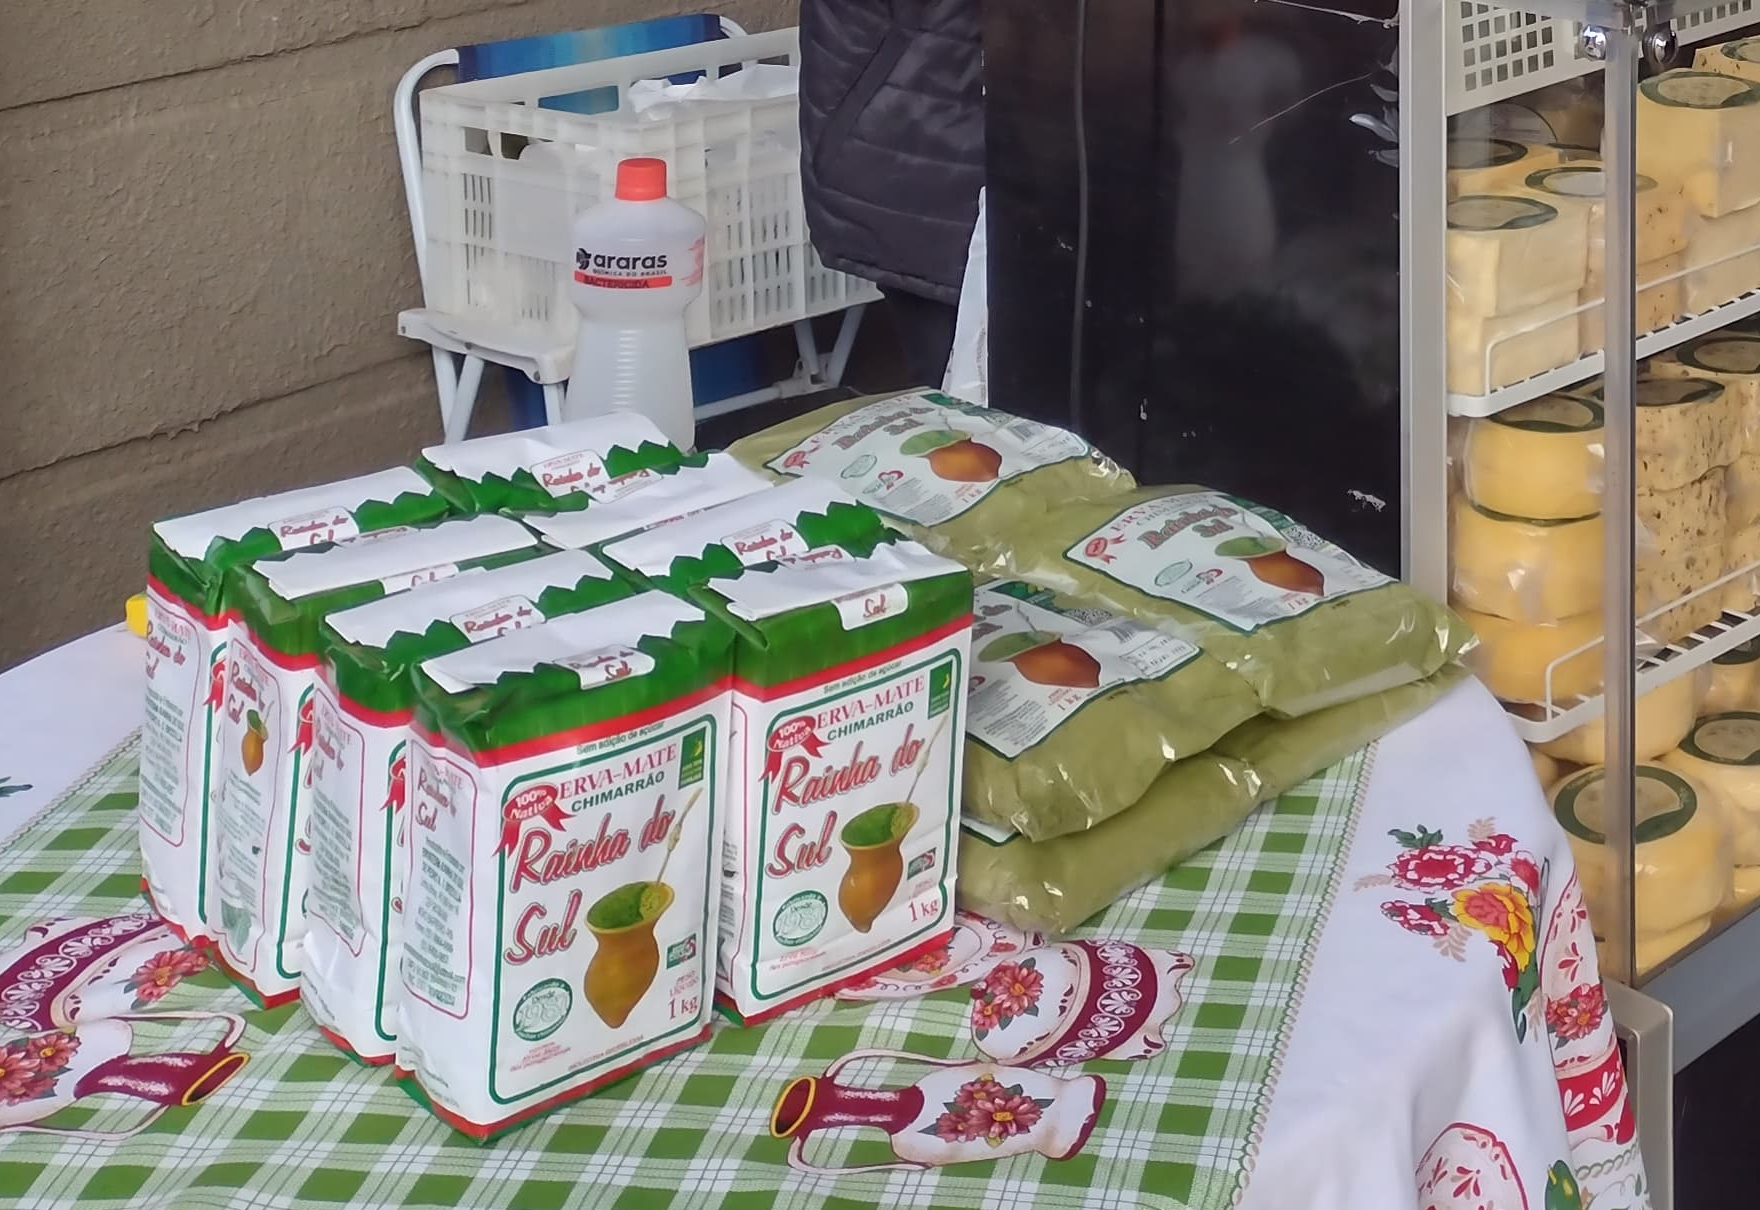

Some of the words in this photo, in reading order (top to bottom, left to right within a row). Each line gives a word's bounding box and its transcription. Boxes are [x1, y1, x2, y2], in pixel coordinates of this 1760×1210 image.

[593, 254, 668, 270] araras
[863, 593, 887, 619] Sul
[816, 675, 925, 730] ERVA-MATE
[777, 720, 806, 739] 100%
[827, 701, 914, 741] CHIMARRÃO
[576, 743, 597, 756] Sem
[598, 732, 628, 752] adição
[629, 730, 638, 742] de
[773, 726, 812, 751] Nativa
[557, 742, 678, 801] ERVA-MATE
[771, 740, 883, 815] Rainha
[888, 723, 926, 777] do
[514, 788, 548, 808] 100%
[571, 770, 666, 813] CHIMARRÃO
[509, 795, 554, 821] Nativa
[509, 812, 631, 893] Rainha
[638, 794, 676, 853] do
[765, 810, 838, 879] Sul
[907, 902, 918, 921] 1
[920, 898, 938, 917] kg
[504, 889, 583, 965] Sul
[667, 1000, 677, 1020] 1
[680, 996, 699, 1015] kg
